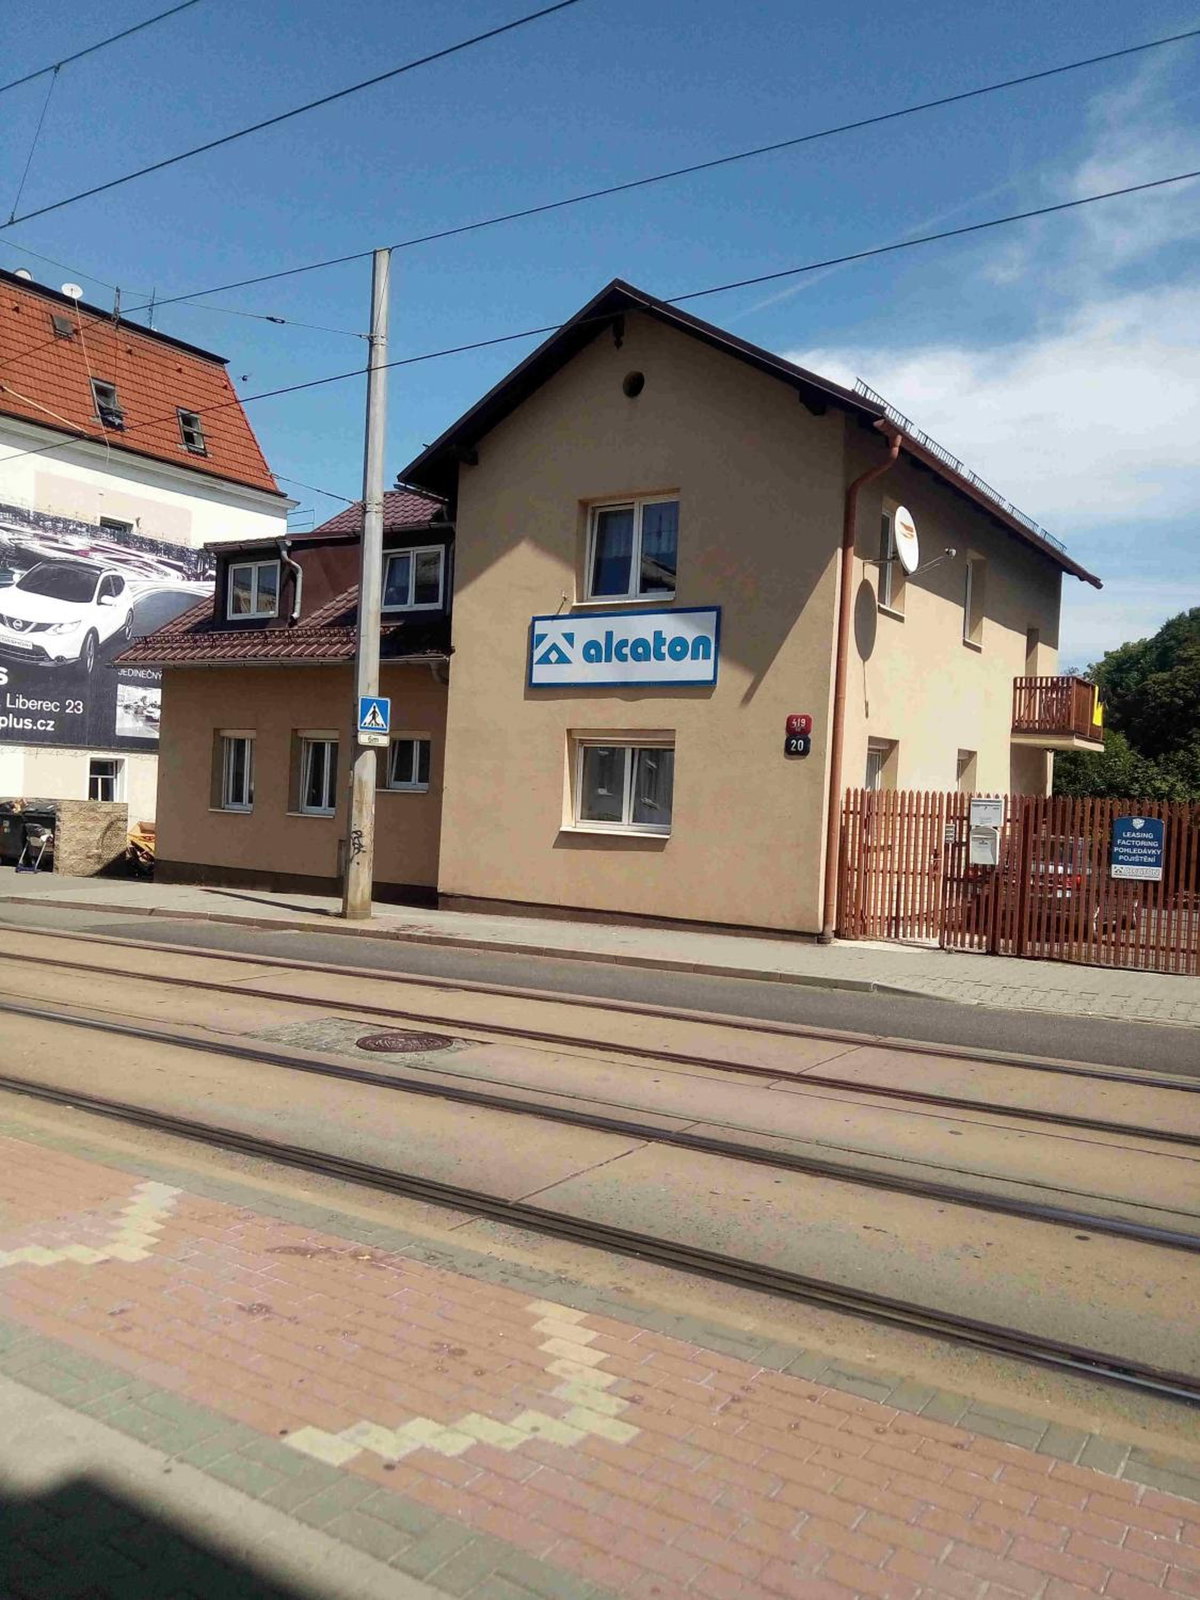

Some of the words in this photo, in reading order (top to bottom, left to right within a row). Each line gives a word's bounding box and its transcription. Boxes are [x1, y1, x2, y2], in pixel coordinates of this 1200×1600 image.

[582, 630, 712, 664] alcaton
[6, 693, 60, 712] Liberec
[65, 700, 83, 714] 23
[790, 739, 804, 751] 20
[1122, 831, 1154, 839] LEASING
[1117, 839, 1159, 847] FACTORING
[1113, 846, 1162, 855] POHLEDÁVKY
